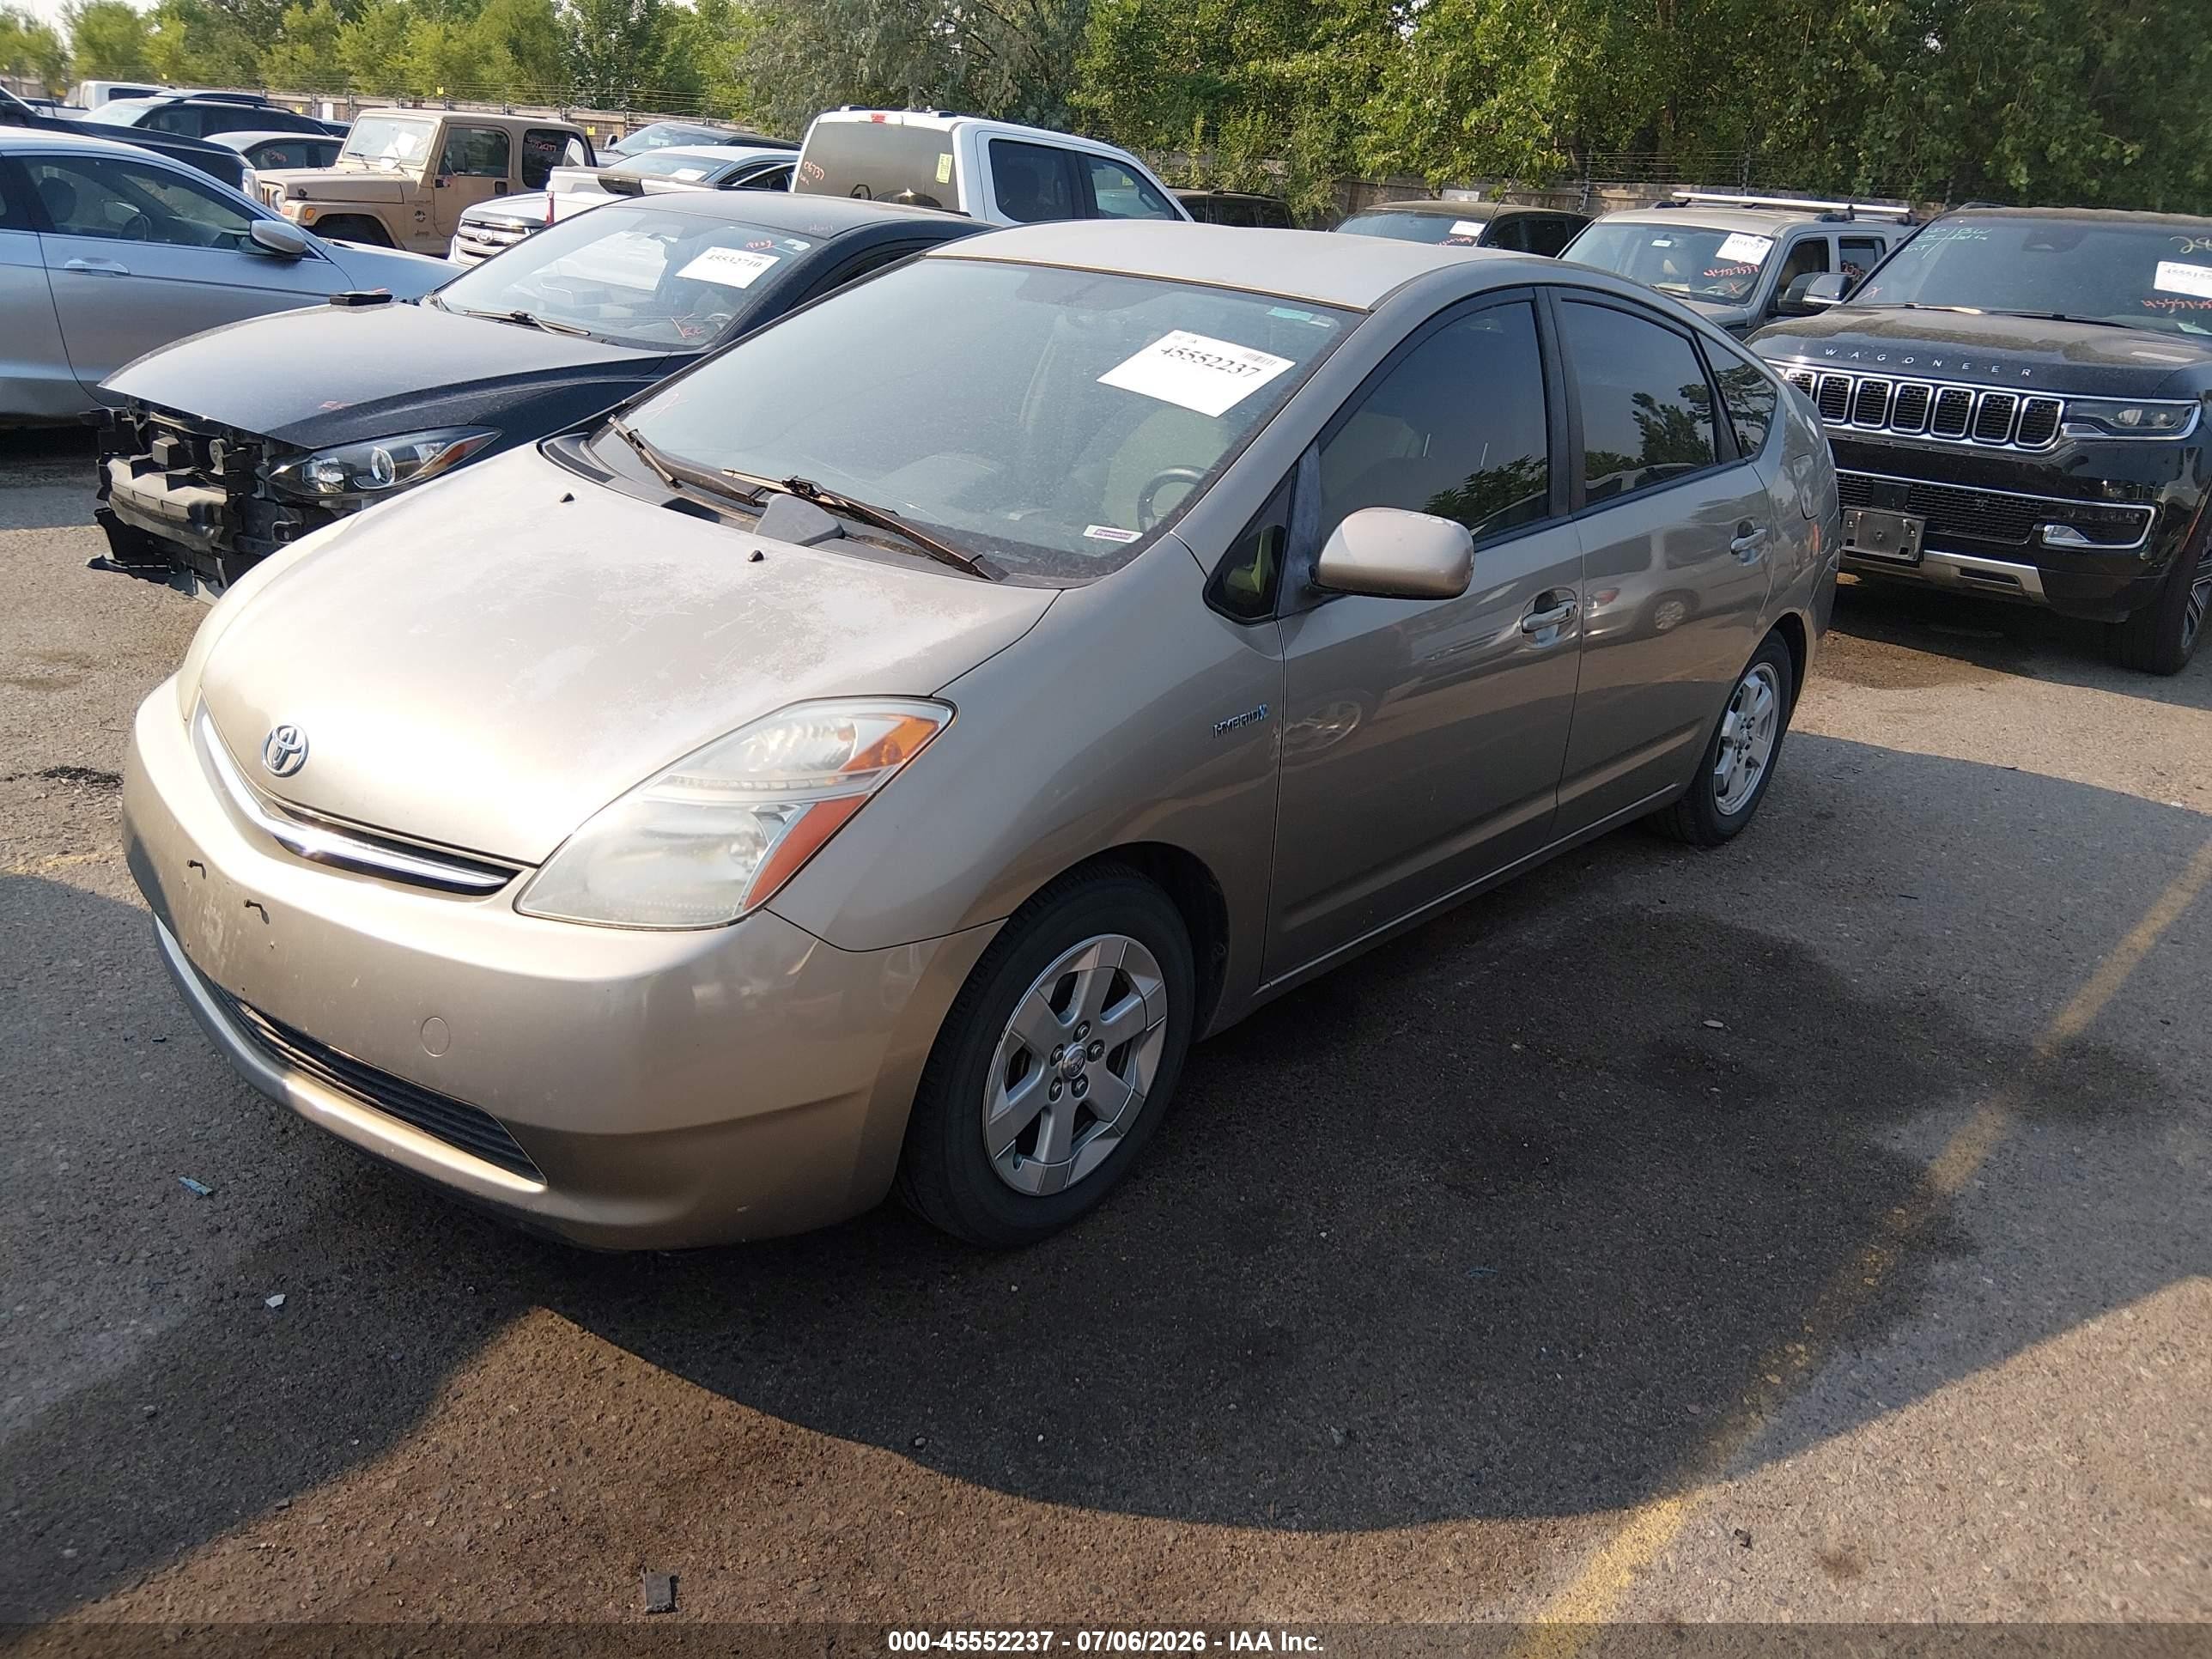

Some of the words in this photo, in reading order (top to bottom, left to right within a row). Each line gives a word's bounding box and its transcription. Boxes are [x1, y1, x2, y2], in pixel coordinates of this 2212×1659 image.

[1160, 345, 1262, 378] 45552237
[1824, 347, 2033, 378] WAGONEER
[1212, 710, 1261, 738] HYBRID
